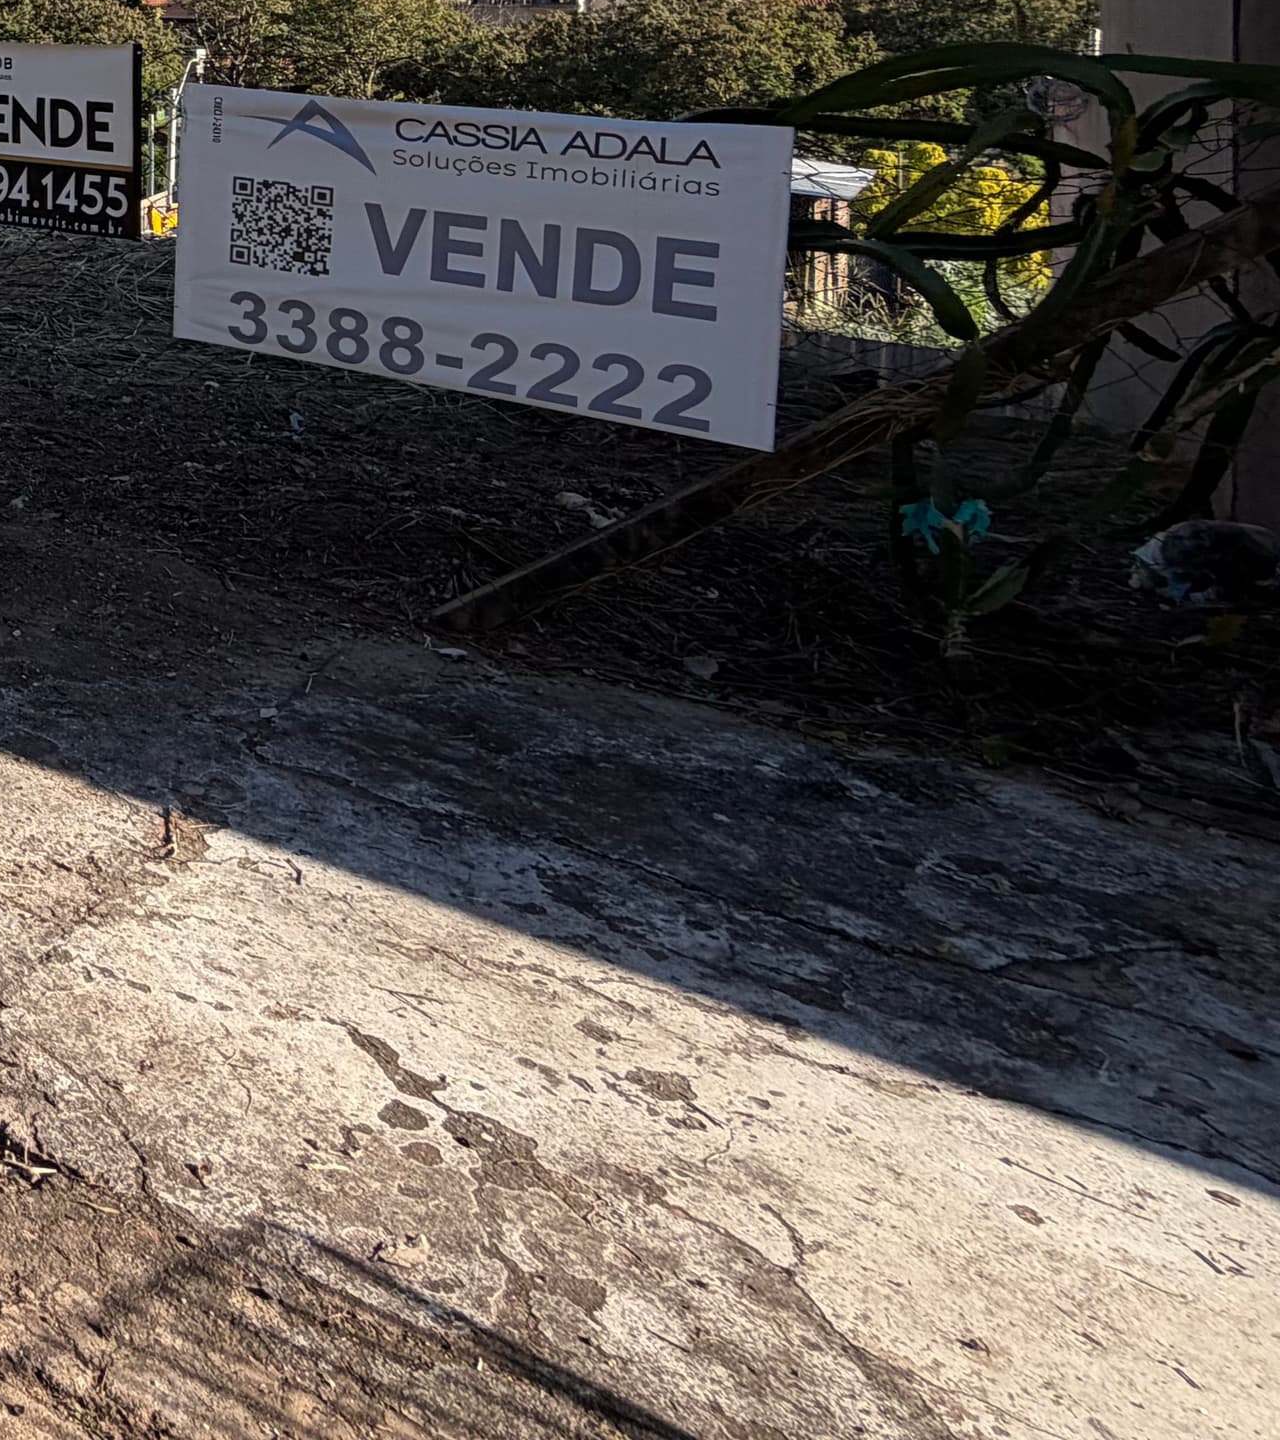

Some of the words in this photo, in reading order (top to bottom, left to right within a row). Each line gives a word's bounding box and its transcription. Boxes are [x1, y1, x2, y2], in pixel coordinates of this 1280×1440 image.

[392, 148, 517, 177] Soluções
[526, 161, 720, 196] Imobiliárias
[395, 118, 548, 154] CASSIA
[560, 130, 721, 169] ADALA
[364, 202, 720, 322] VENDE
[227, 290, 713, 433] 3388-2222
